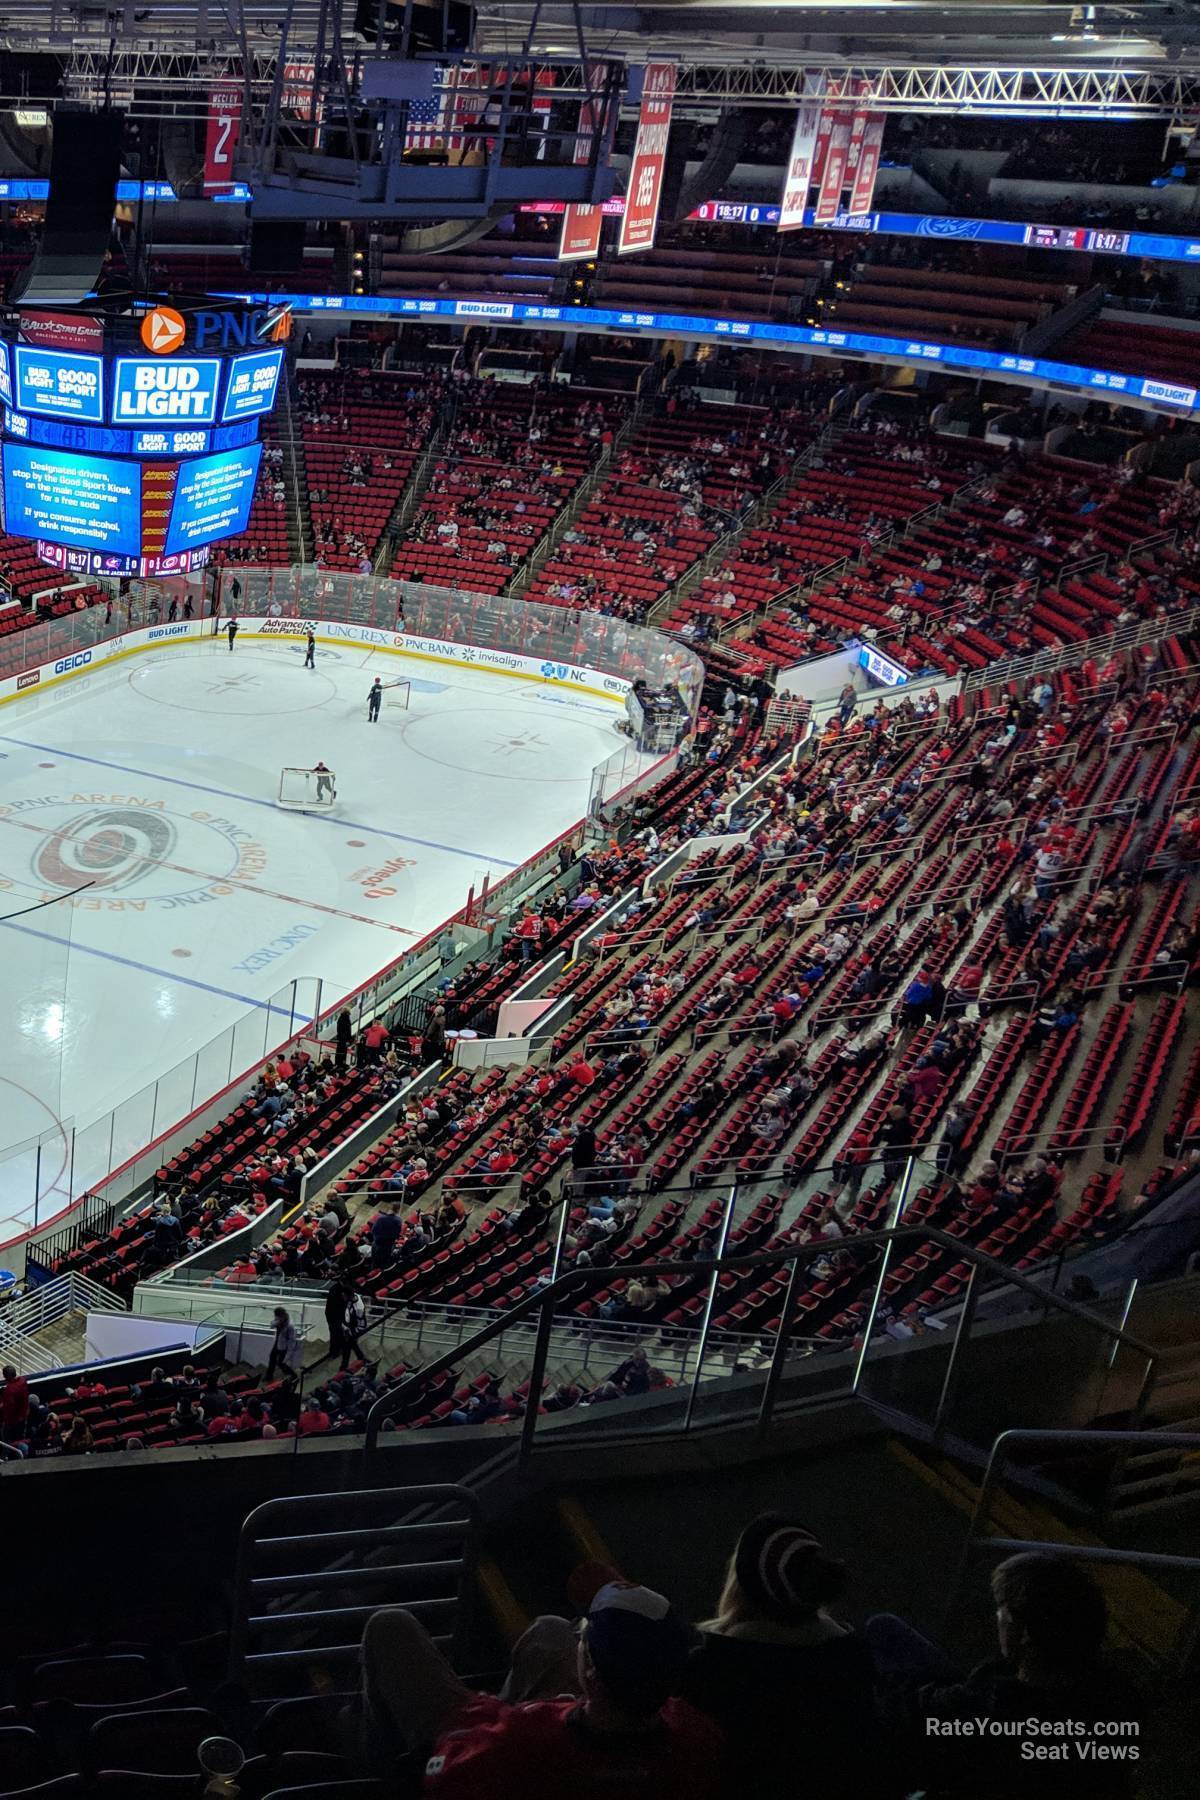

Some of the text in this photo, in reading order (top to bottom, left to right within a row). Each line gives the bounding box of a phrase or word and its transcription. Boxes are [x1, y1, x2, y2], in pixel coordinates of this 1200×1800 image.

[214, 115, 231, 163] 2
[718, 203, 743, 218] 18:17
[460, 304, 509, 315] BUD LIGHT
[194, 310, 267, 347] PNC
[27, 366, 50, 379] BUD
[57, 368, 97, 386] GOOD
[134, 367, 200, 391] BUD
[253, 365, 277, 381] GOOD
[24, 375, 54, 389] LIGHT
[58, 381, 97, 397] SPORT
[251, 378, 275, 393] SPORT
[1146, 384, 1190, 402] BUD LIGHT
[120, 391, 208, 415] LIGHT
[142, 434, 165, 444] BUD
[173, 431, 206, 443] GOOD
[137, 442, 169, 452] LIGHT
[173, 441, 205, 452] SPORT
[30, 461, 77, 477] Designated
[12, 468, 31, 480] stop
[32, 471, 42, 483] by
[44, 473, 58, 483] the
[82, 479, 106, 491] Sport
[107, 483, 132, 495] Kiosk
[25, 482, 36, 490] on
[37, 482, 51, 491] the
[74, 488, 118, 503] concourse
[40, 493, 52, 502] for
[61, 496, 79, 507] free
[24, 506, 32, 516] If
[33, 509, 48, 518] you
[49, 512, 87, 526] consume
[38, 520, 108, 541] drink responsibly
[68, 552, 87, 566] 18:17
[93, 555, 101, 569] 0
[148, 625, 188, 639] BUD LIGHT
[264, 619, 303, 629] Advance
[279, 627, 302, 635] Parts
[327, 624, 389, 645] UNC REX
[54, 650, 92, 675] GEICO
[478, 651, 523, 669] invisalign
[18, 674, 39, 686] Lenovo
[570, 669, 587, 683] NC
[8, 793, 168, 811] PNC ARENA
[205, 817, 267, 881] PNC ARENA
[360, 856, 417, 888] Syneos
[40, 891, 216, 911] PNC ARENA
[231, 923, 320, 975] UNC REX
